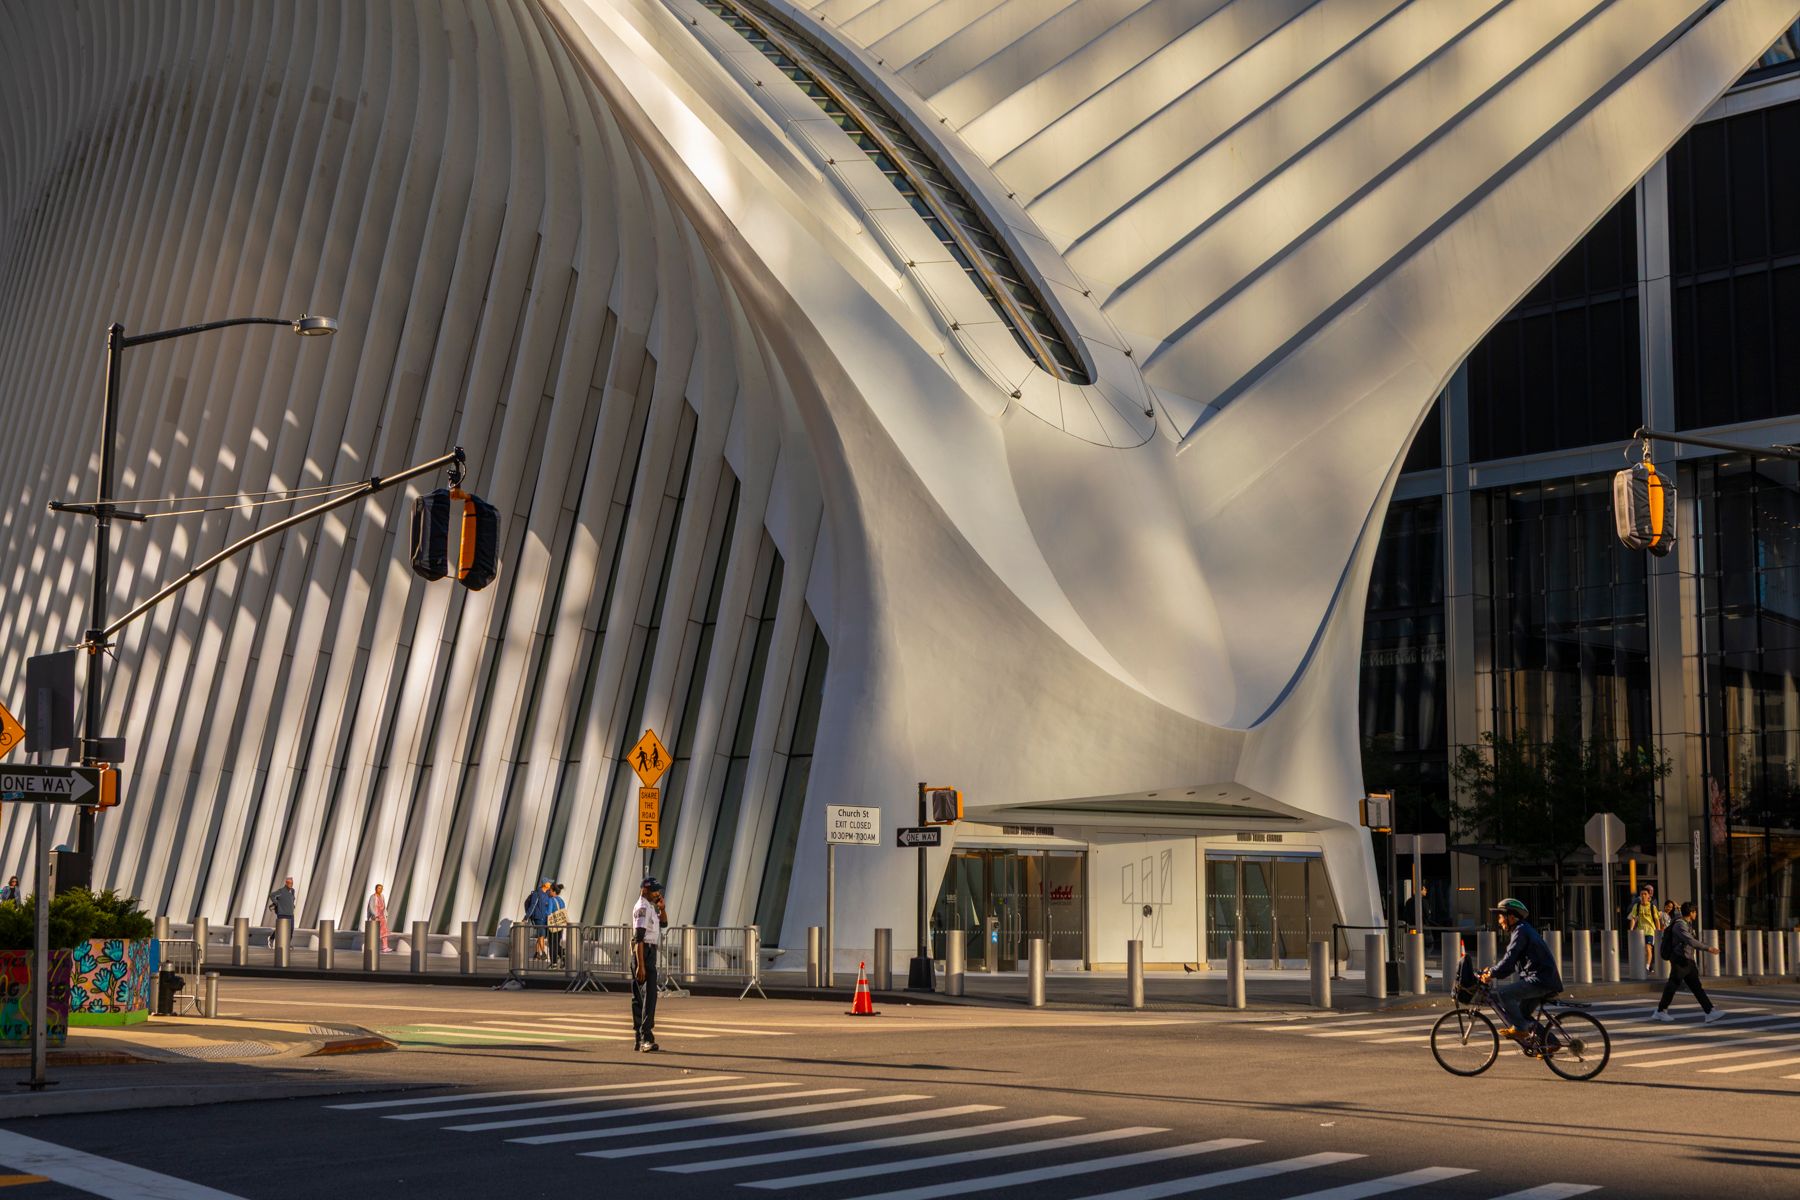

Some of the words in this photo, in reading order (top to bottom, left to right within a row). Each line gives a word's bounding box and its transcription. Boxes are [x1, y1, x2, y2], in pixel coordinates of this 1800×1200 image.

[3, 776, 35, 791] ONE
[42, 778, 75, 793] WAY
[641, 791, 657, 799] SHARE
[644, 801, 654, 810] THE
[641, 811, 656, 819] ROAD
[838, 808, 861, 818] Church
[862, 810, 869, 818] St
[835, 820, 847, 828] EXIT
[849, 821, 872, 830] CLOSED
[644, 823, 653, 837] 5
[906, 833, 920, 842] ONE
[921, 833, 936, 841] WAY
